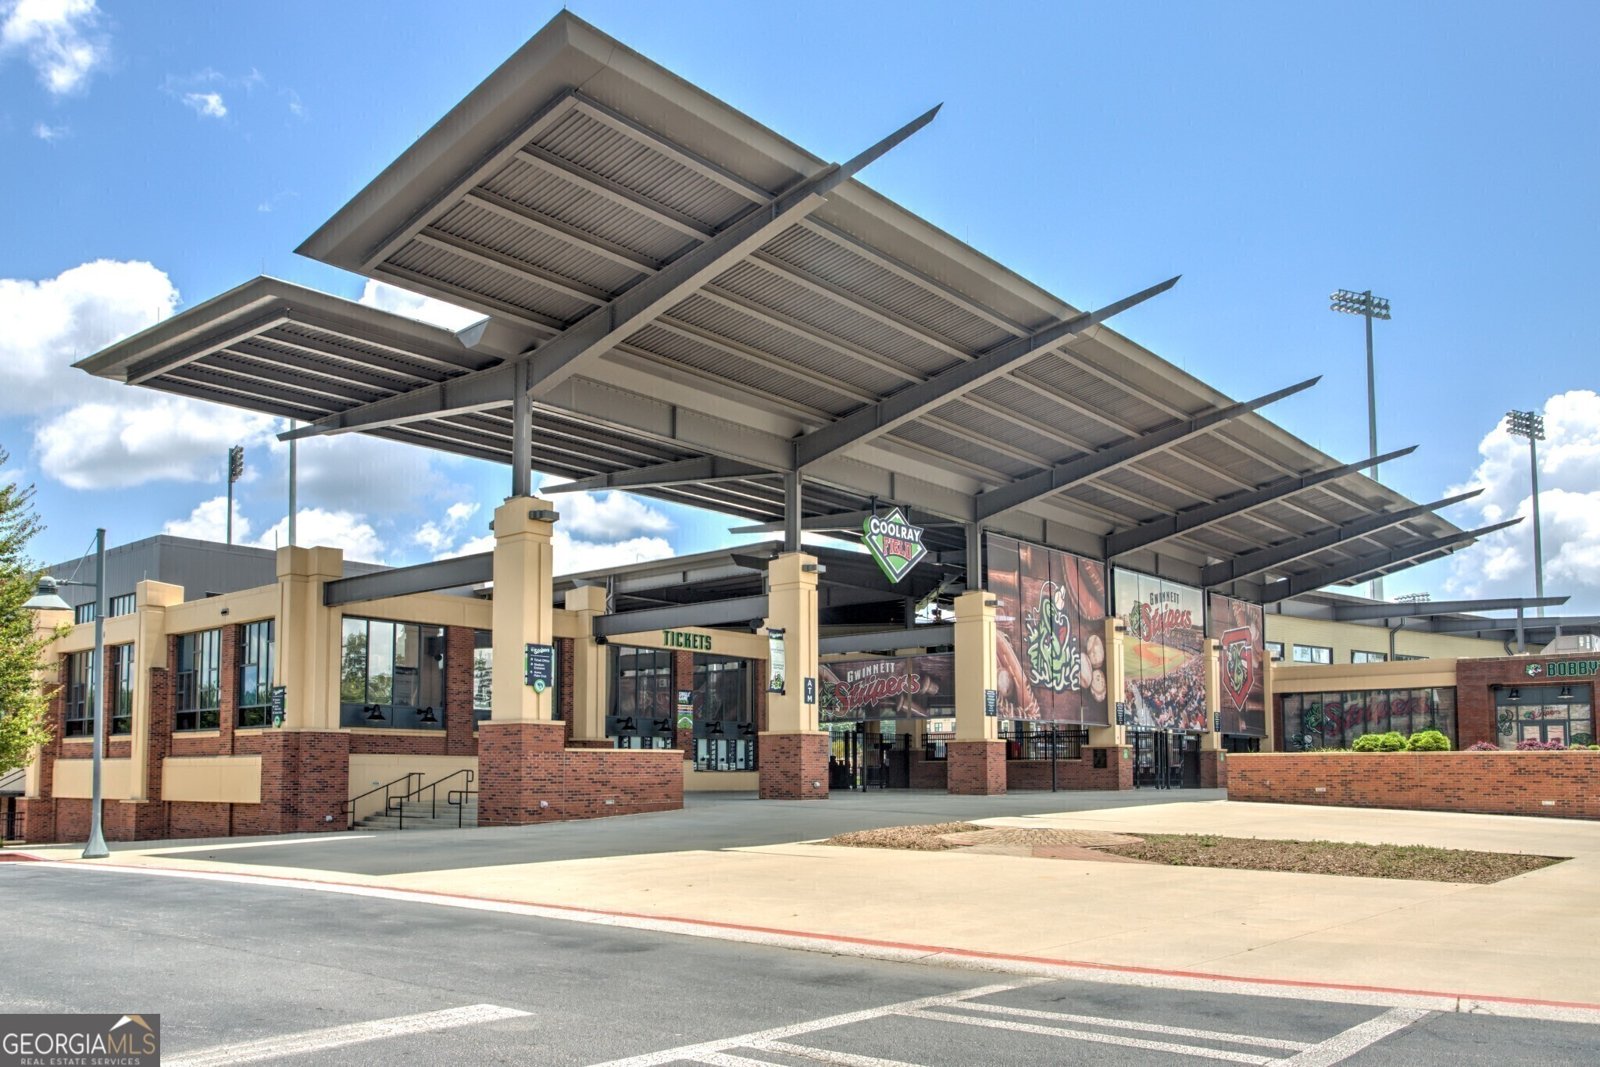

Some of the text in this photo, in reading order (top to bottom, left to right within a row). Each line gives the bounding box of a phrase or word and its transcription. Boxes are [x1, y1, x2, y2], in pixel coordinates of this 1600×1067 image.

[870, 518, 920, 542] COOLRAY
[882, 536, 912, 561] FIELD
[1149, 591, 1180, 605] GWINNETT
[1140, 602, 1192, 642] Stripers
[662, 630, 712, 650] TICKETS
[847, 662, 895, 682] GWINNETT
[834, 674, 921, 718] Stripers
